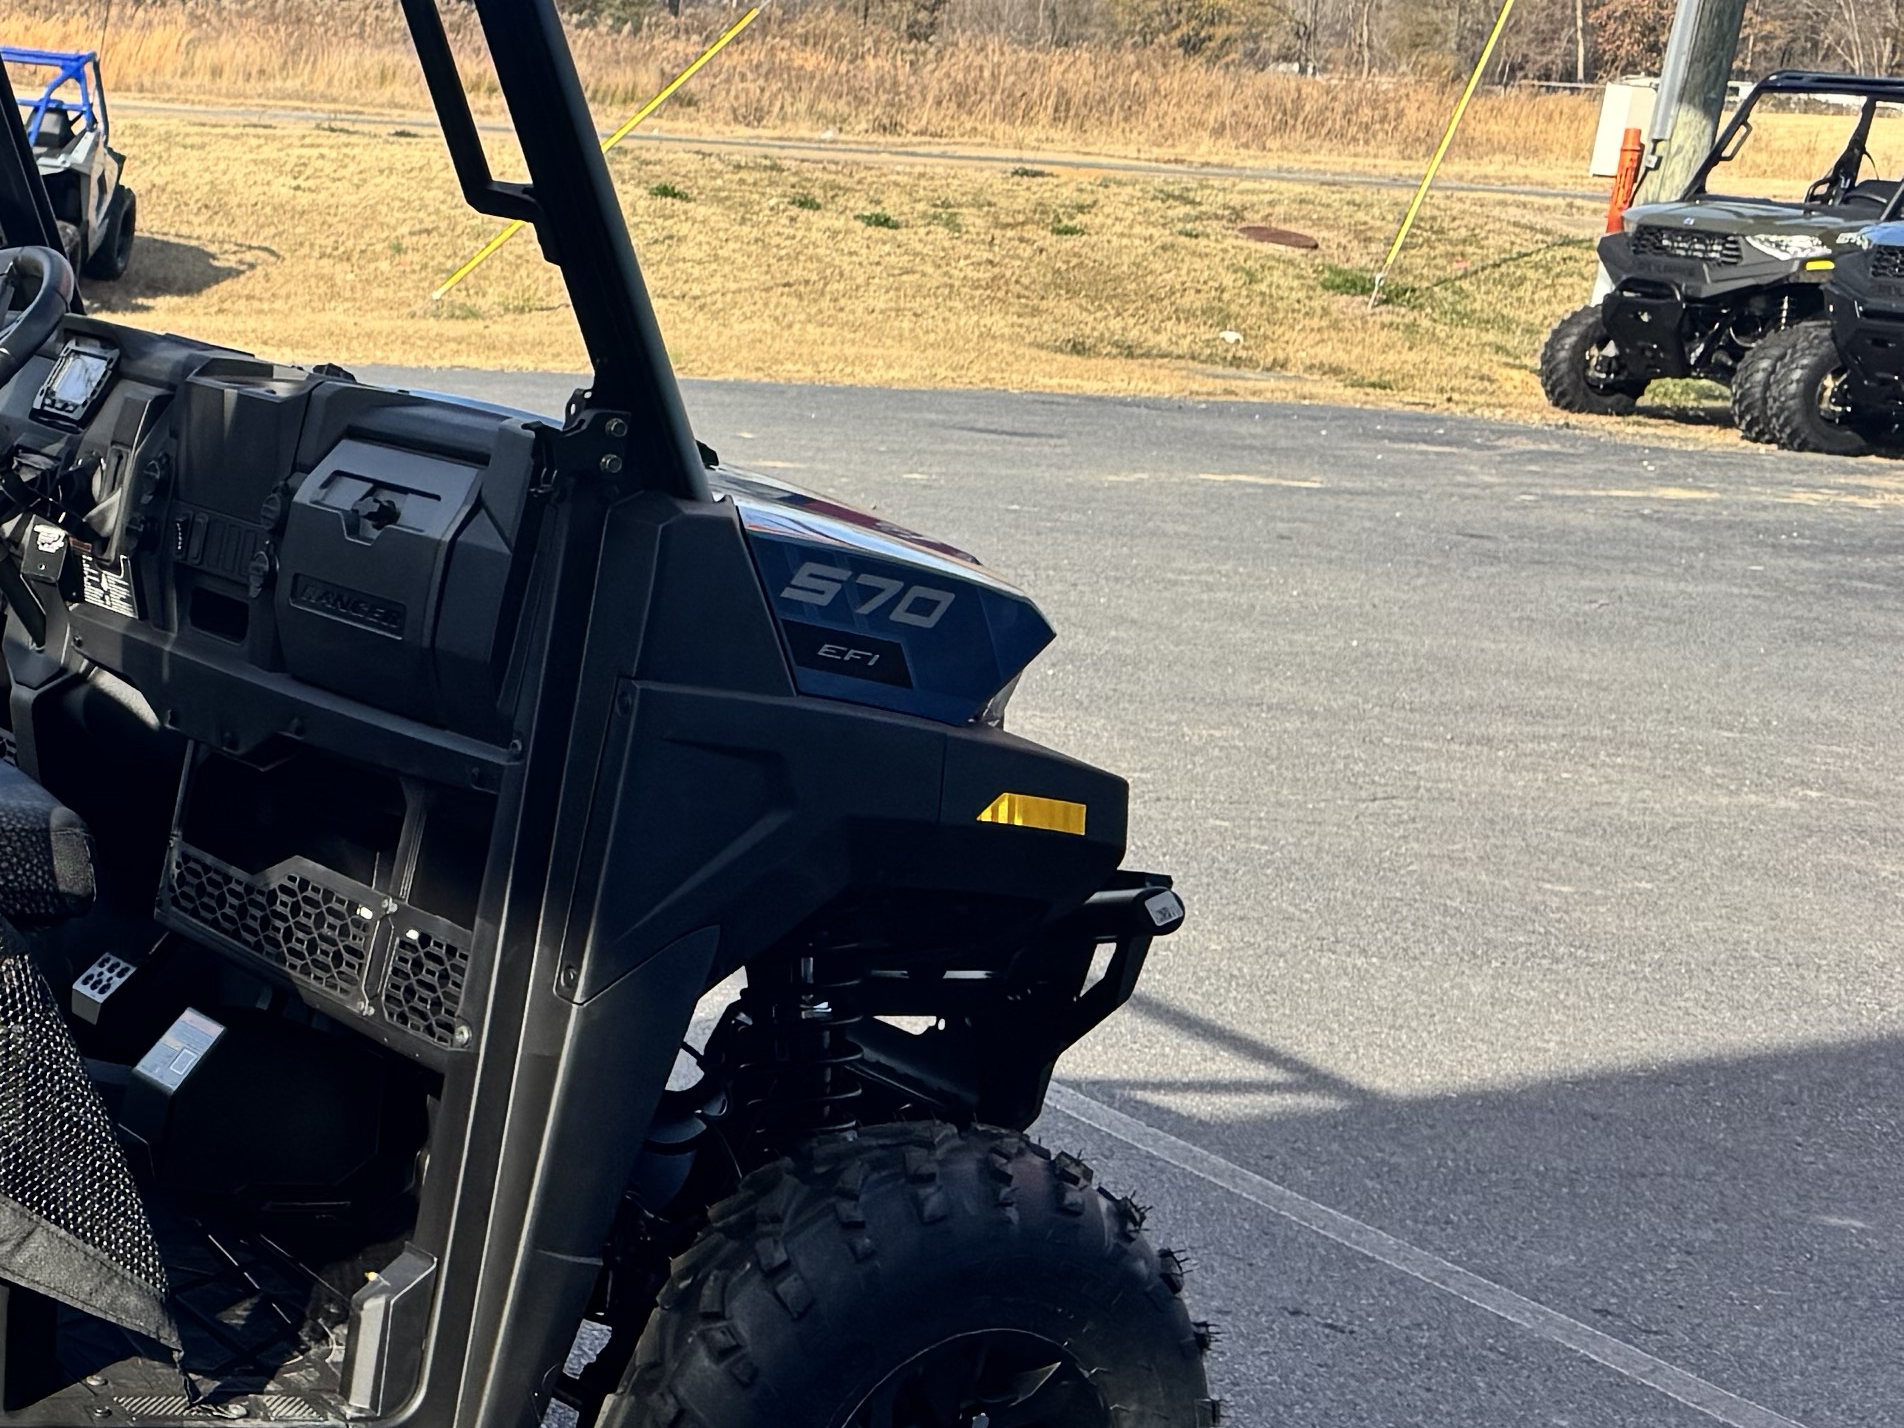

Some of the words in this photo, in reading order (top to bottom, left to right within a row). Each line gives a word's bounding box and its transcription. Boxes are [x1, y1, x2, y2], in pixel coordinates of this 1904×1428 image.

[299, 581, 400, 629] RANGER
[780, 561, 956, 629] 570
[817, 643, 881, 667] EFI
